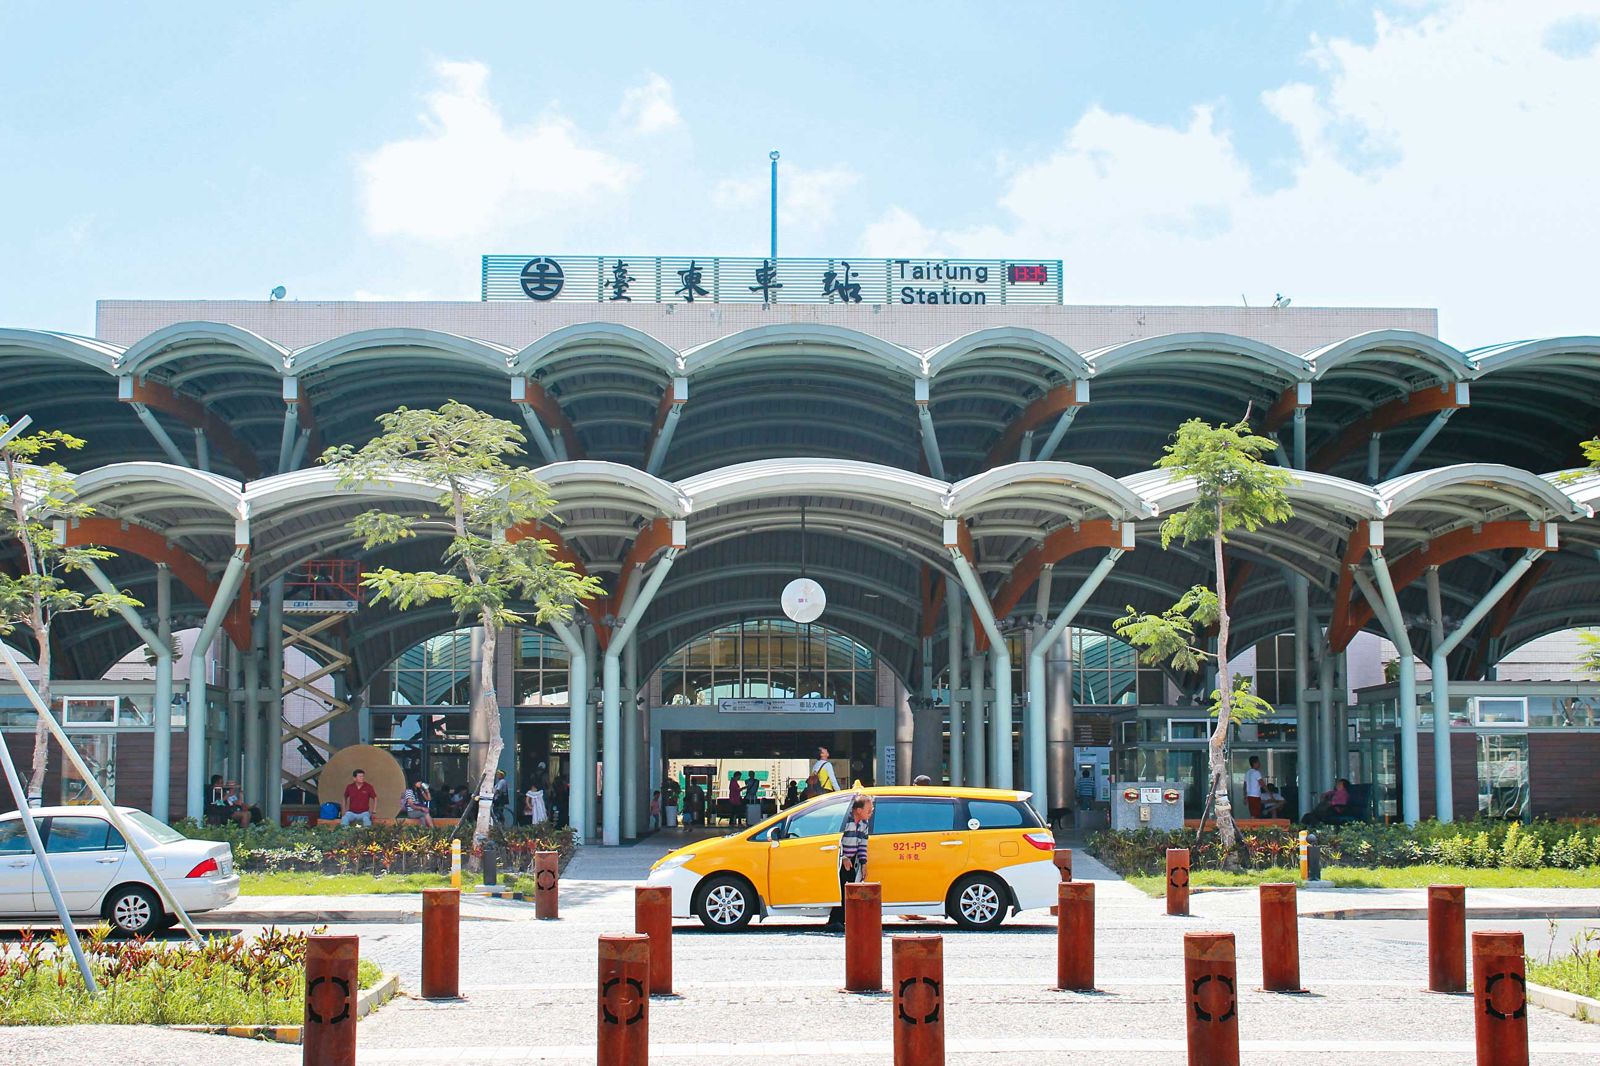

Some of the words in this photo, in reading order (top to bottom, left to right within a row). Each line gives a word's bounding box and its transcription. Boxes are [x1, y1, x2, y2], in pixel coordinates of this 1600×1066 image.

[604, 259, 863, 303] 臺東車站
[895, 260, 988, 283] Taitung
[901, 286, 987, 305] Station
[893, 842, 927, 851] 921-P9
